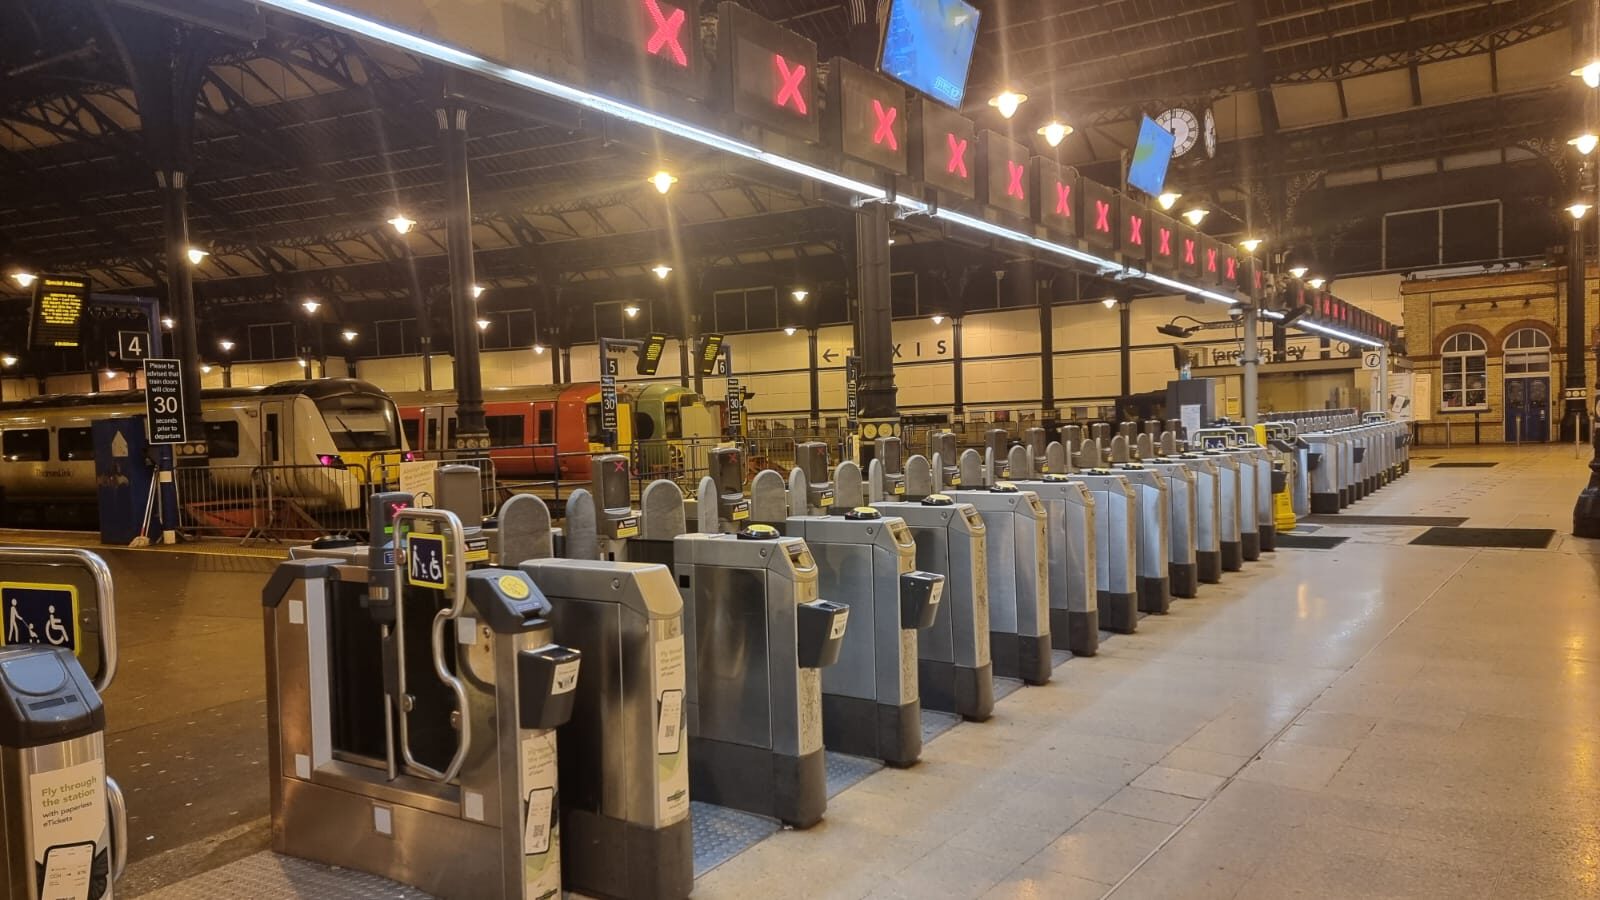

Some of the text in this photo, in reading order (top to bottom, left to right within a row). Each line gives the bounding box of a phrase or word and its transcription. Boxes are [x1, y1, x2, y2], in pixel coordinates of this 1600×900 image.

[128, 336, 142, 356] 4
[149, 362, 166, 370] Please
[609, 360, 615, 373] 5
[719, 361, 725, 373] 6
[154, 396, 178, 414] 30
[604, 399, 615, 410] 30
[730, 399, 739, 409] 30
[154, 433, 182, 441] departure
[41, 775, 97, 798] Fly through
[42, 789, 96, 808] the station
[42, 801, 93, 818] with paperless
[42, 816, 73, 828] eTickets
